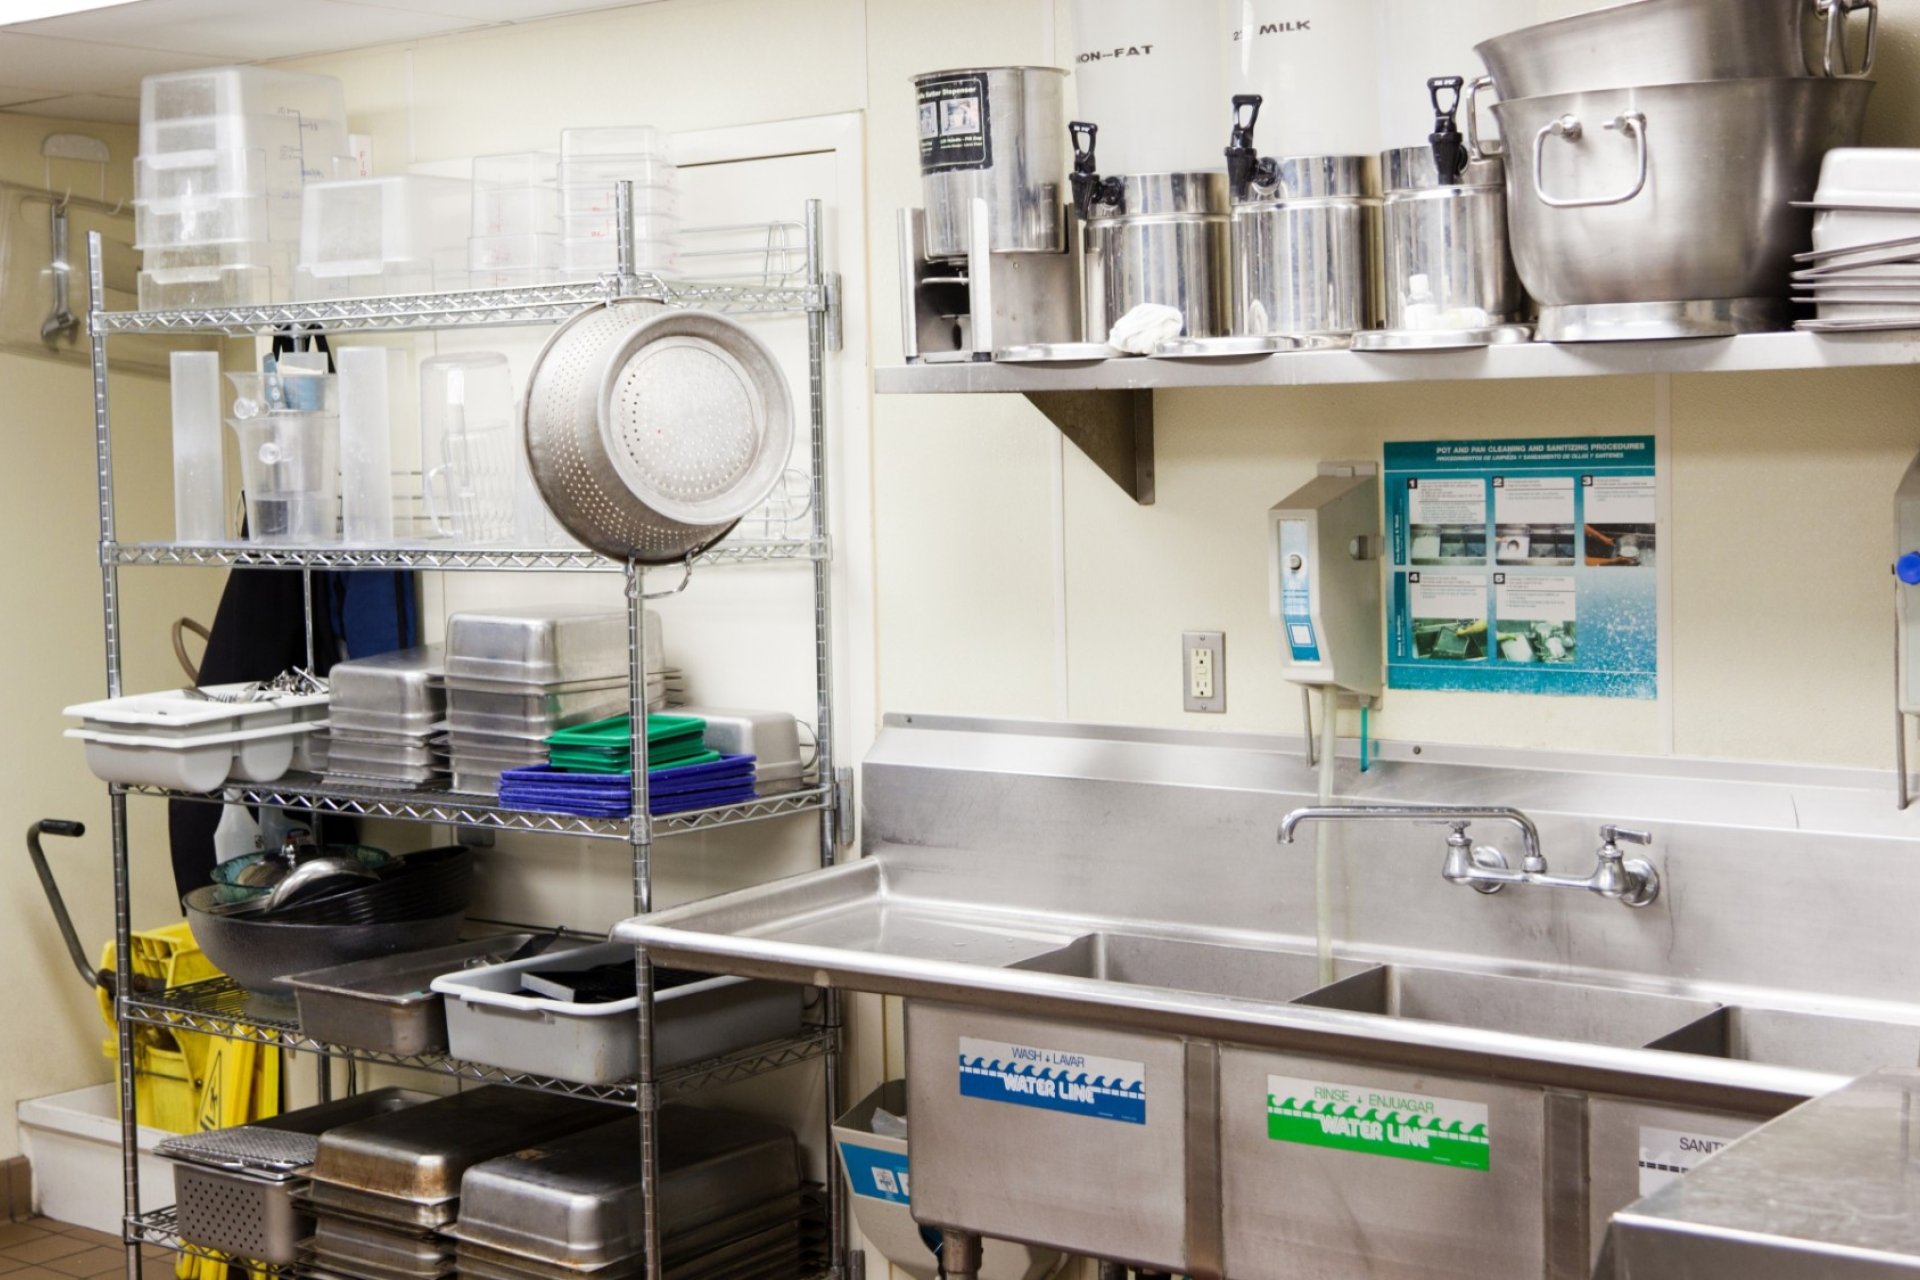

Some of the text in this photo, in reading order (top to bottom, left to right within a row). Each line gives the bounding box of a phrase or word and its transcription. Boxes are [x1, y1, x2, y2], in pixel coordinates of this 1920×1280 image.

[1259, 20, 1310, 35] MILK
[1436, 446, 1451, 454] POT
[1471, 445, 1486, 453] PAN
[1488, 444, 1526, 453] CLEANING
[1528, 444, 1544, 452] AND
[1546, 443, 1589, 451] SANITIZING
[1590, 442, 1645, 450] PROCEDURES
[1011, 1046, 1085, 1067] WASH LAVAR
[1003, 1072, 1095, 1104] WATER LINE
[1314, 1086, 1435, 1114] RINSE ENJUAGAR
[1320, 1115, 1430, 1149] WATER LINE
[1679, 1137, 1728, 1154] SANIT
